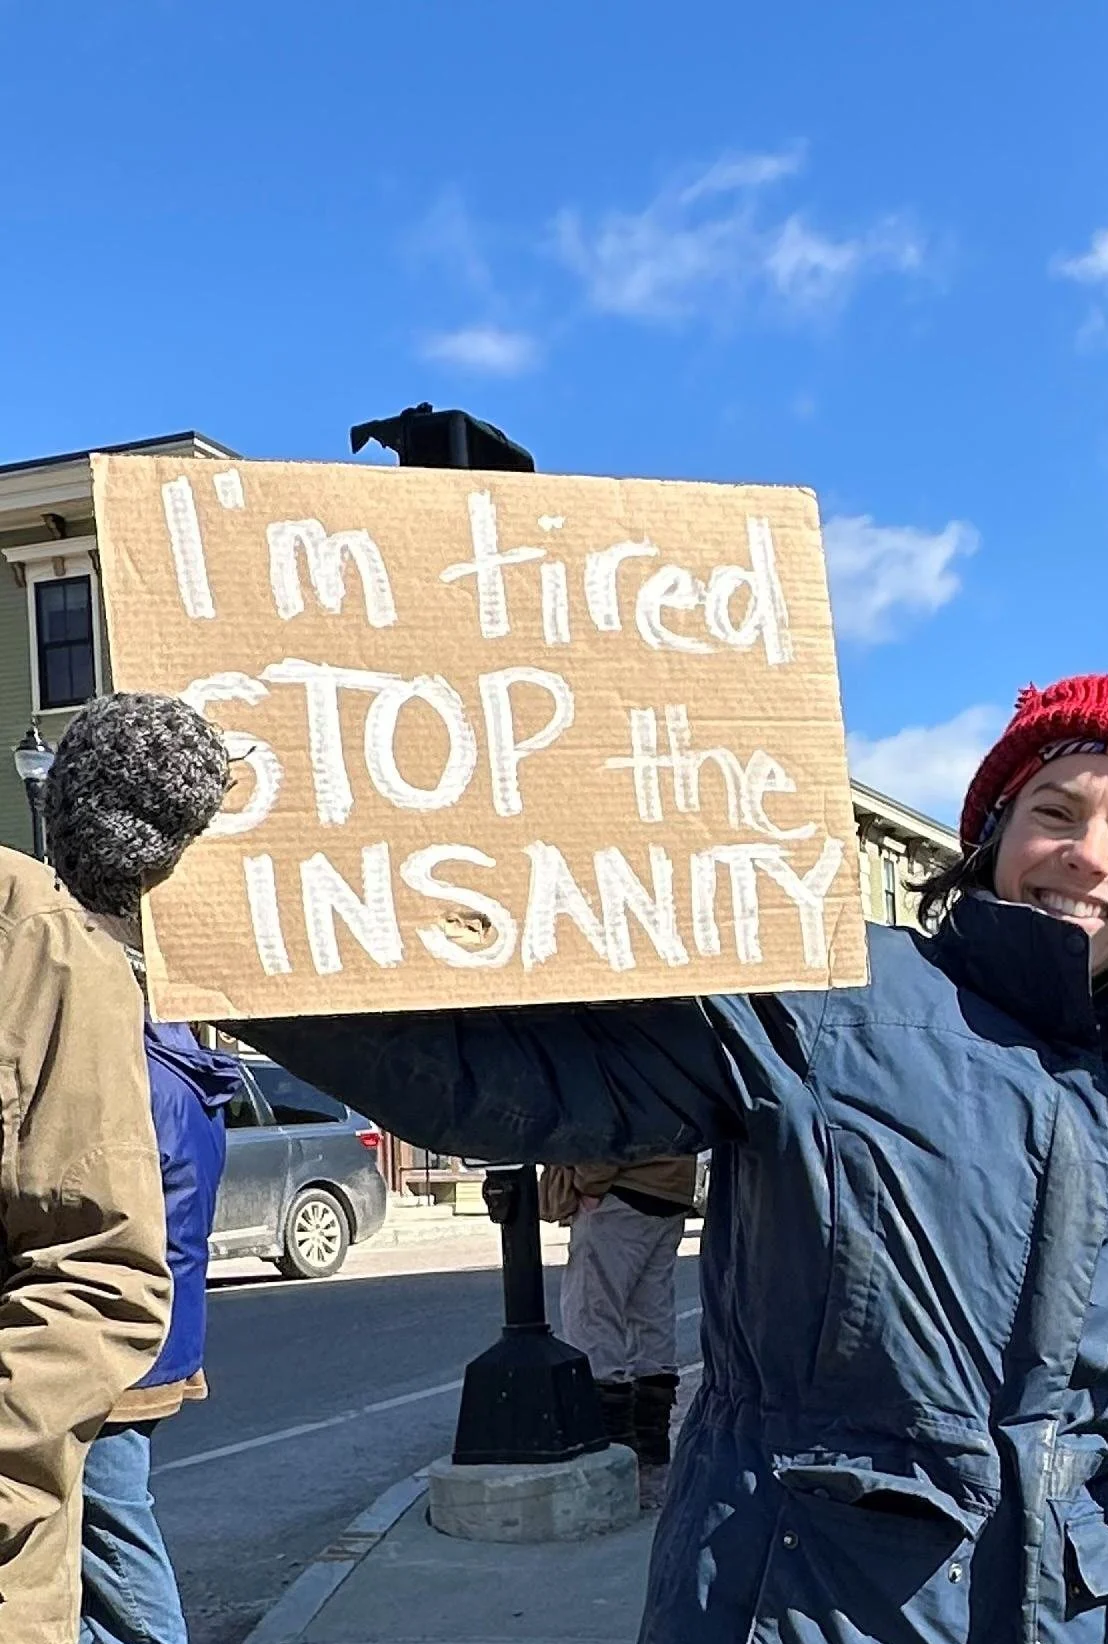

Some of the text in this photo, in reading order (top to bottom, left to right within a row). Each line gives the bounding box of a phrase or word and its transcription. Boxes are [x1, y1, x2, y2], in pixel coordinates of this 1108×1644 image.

[160, 468, 793, 667] I'm tired
[178, 657, 821, 840] STOP the
[242, 837, 845, 976] INSANITY
